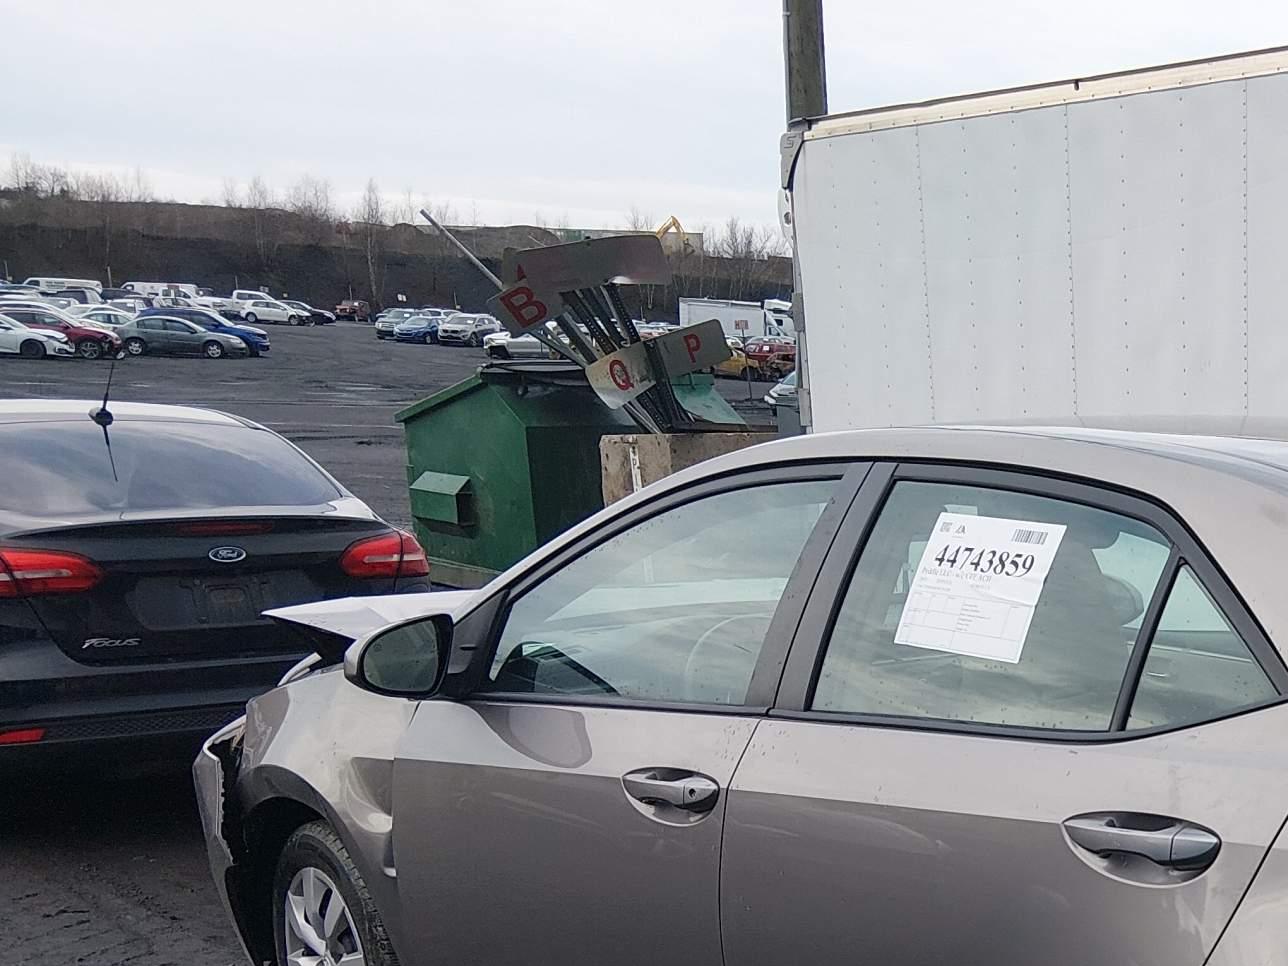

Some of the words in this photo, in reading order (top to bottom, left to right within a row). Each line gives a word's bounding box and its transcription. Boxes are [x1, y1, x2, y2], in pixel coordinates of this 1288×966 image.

[500, 286, 548, 329] B
[682, 333, 701, 363] P
[609, 359, 635, 391] Q
[217, 549, 239, 559] Ford
[934, 543, 1036, 578] 44743859
